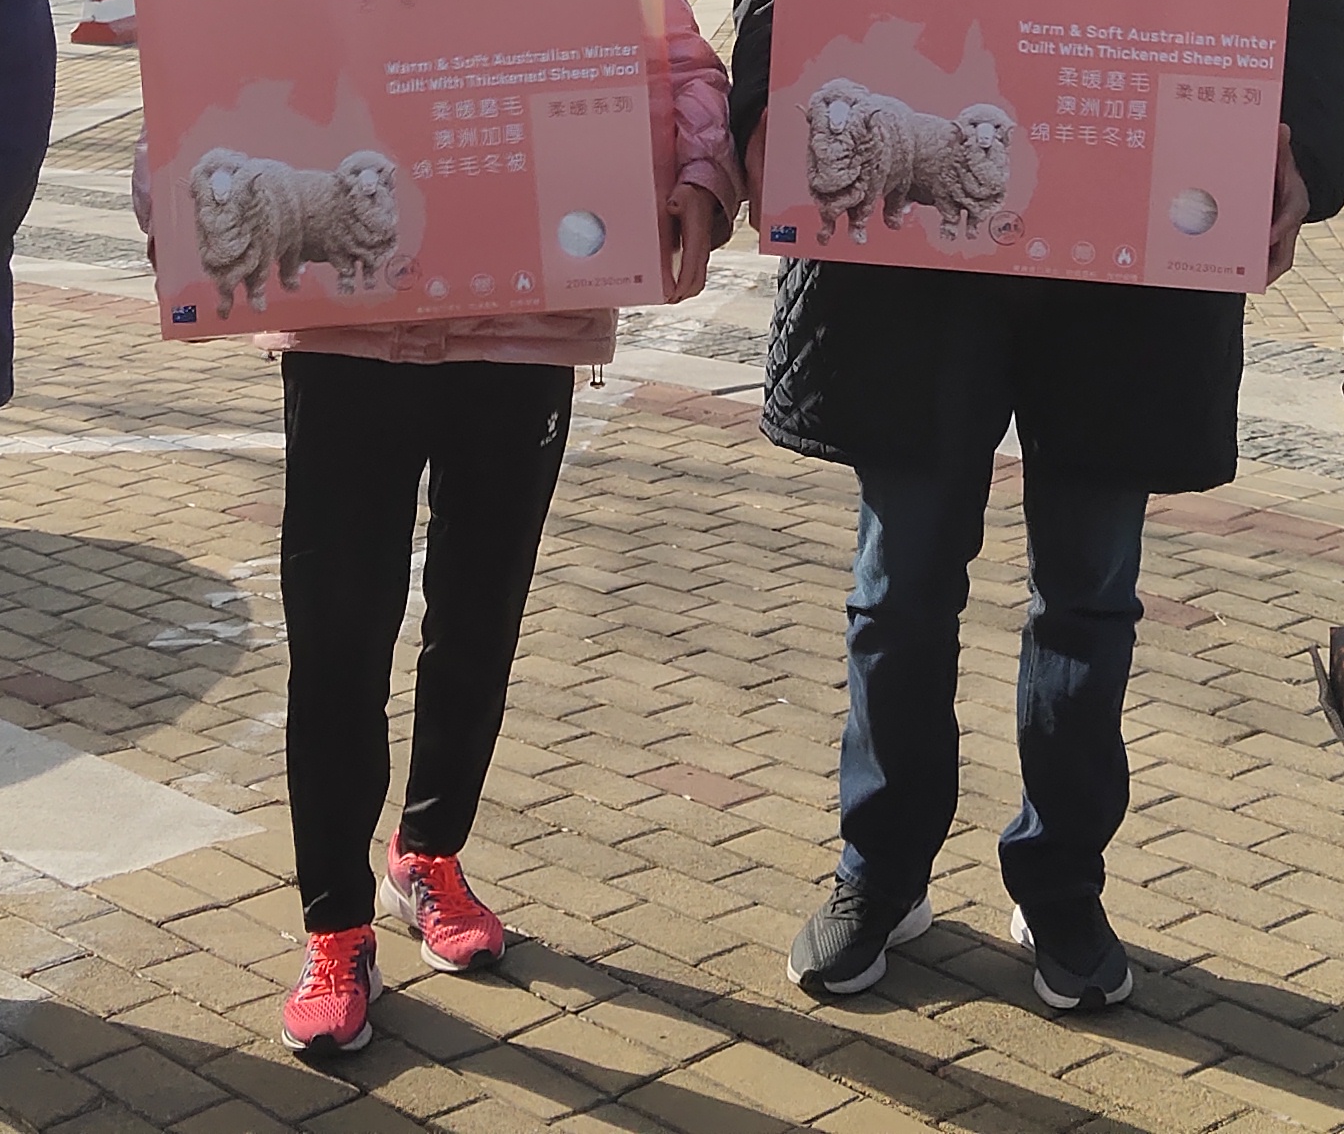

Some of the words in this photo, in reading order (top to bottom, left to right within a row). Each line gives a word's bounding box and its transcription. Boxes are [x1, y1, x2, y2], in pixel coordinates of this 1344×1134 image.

[1019, 20, 1064, 37] Warm
[1069, 23, 1082, 38] &
[1086, 25, 1124, 41] Soft
[1127, 27, 1216, 47] Australian
[1221, 34, 1277, 51] Winter
[386, 59, 436, 75] Warm
[437, 57, 450, 72] &
[453, 53, 490, 70] Soft
[492, 47, 581, 66] Australian
[583, 42, 639, 59] Winter
[1018, 39, 1056, 55] Quilt
[1059, 42, 1094, 58] With
[1097, 44, 1178, 64] Thickened
[1182, 51, 1233, 69] Sheep
[1237, 54, 1275, 70] Wool
[387, 78, 425, 95] Quilt
[428, 74, 465, 91] With
[466, 69, 547, 88] Thickened
[549, 66, 600, 83] Sheep
[602, 61, 640, 77] Wool
[1059, 67, 1151, 93] 柔暖磨毛
[548, 95, 633, 118] 柔暖系列
[1056, 95, 1148, 120] 澳洲加厚
[1176, 83, 1262, 106] 柔暖系列
[432, 95, 523, 122] 柔暖磨毛
[432, 123, 525, 150] 澳洲加厚
[1030, 122, 1146, 149] 绵羊毛冬被
[412, 152, 528, 181] 绵羊毛冬被
